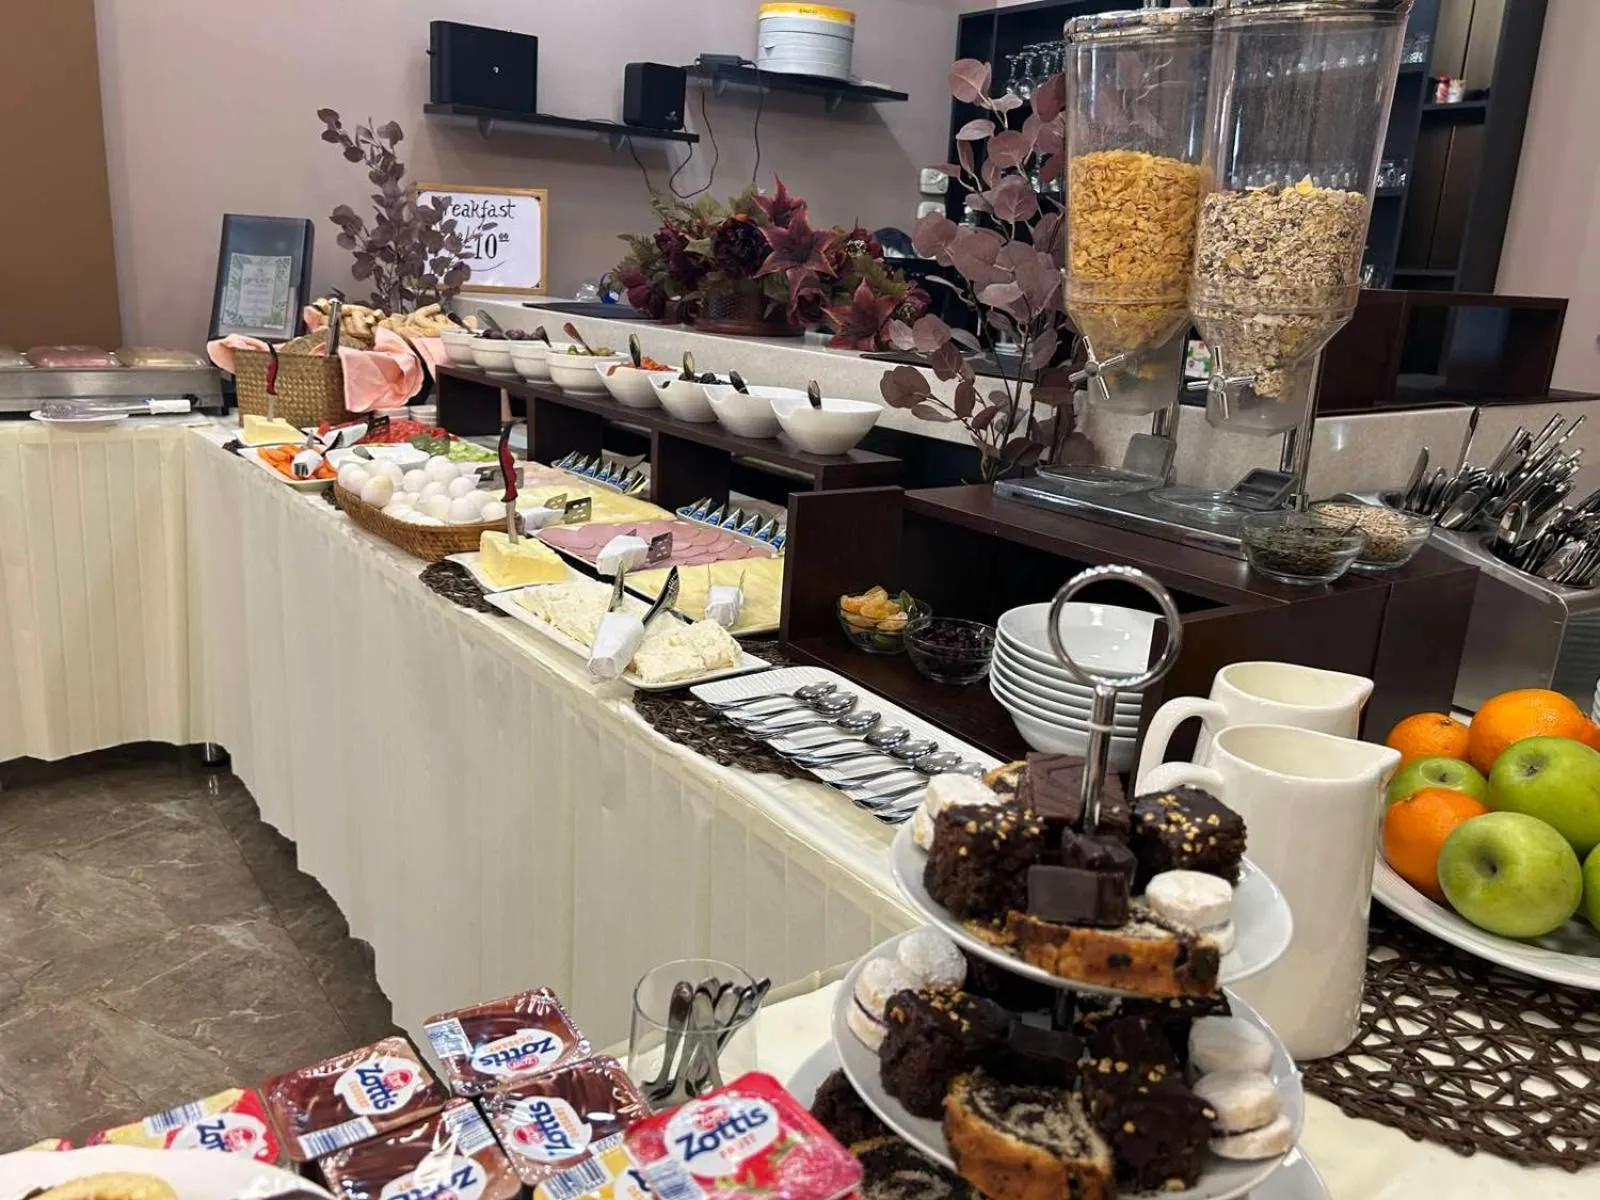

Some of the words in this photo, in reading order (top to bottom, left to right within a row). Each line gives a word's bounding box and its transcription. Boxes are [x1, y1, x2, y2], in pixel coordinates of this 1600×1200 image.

[479, 1036, 556, 1067] Zottis
[355, 1063, 399, 1110] Zottis
[529, 1101, 575, 1156] Zottis
[675, 1107, 769, 1162] Zottis
